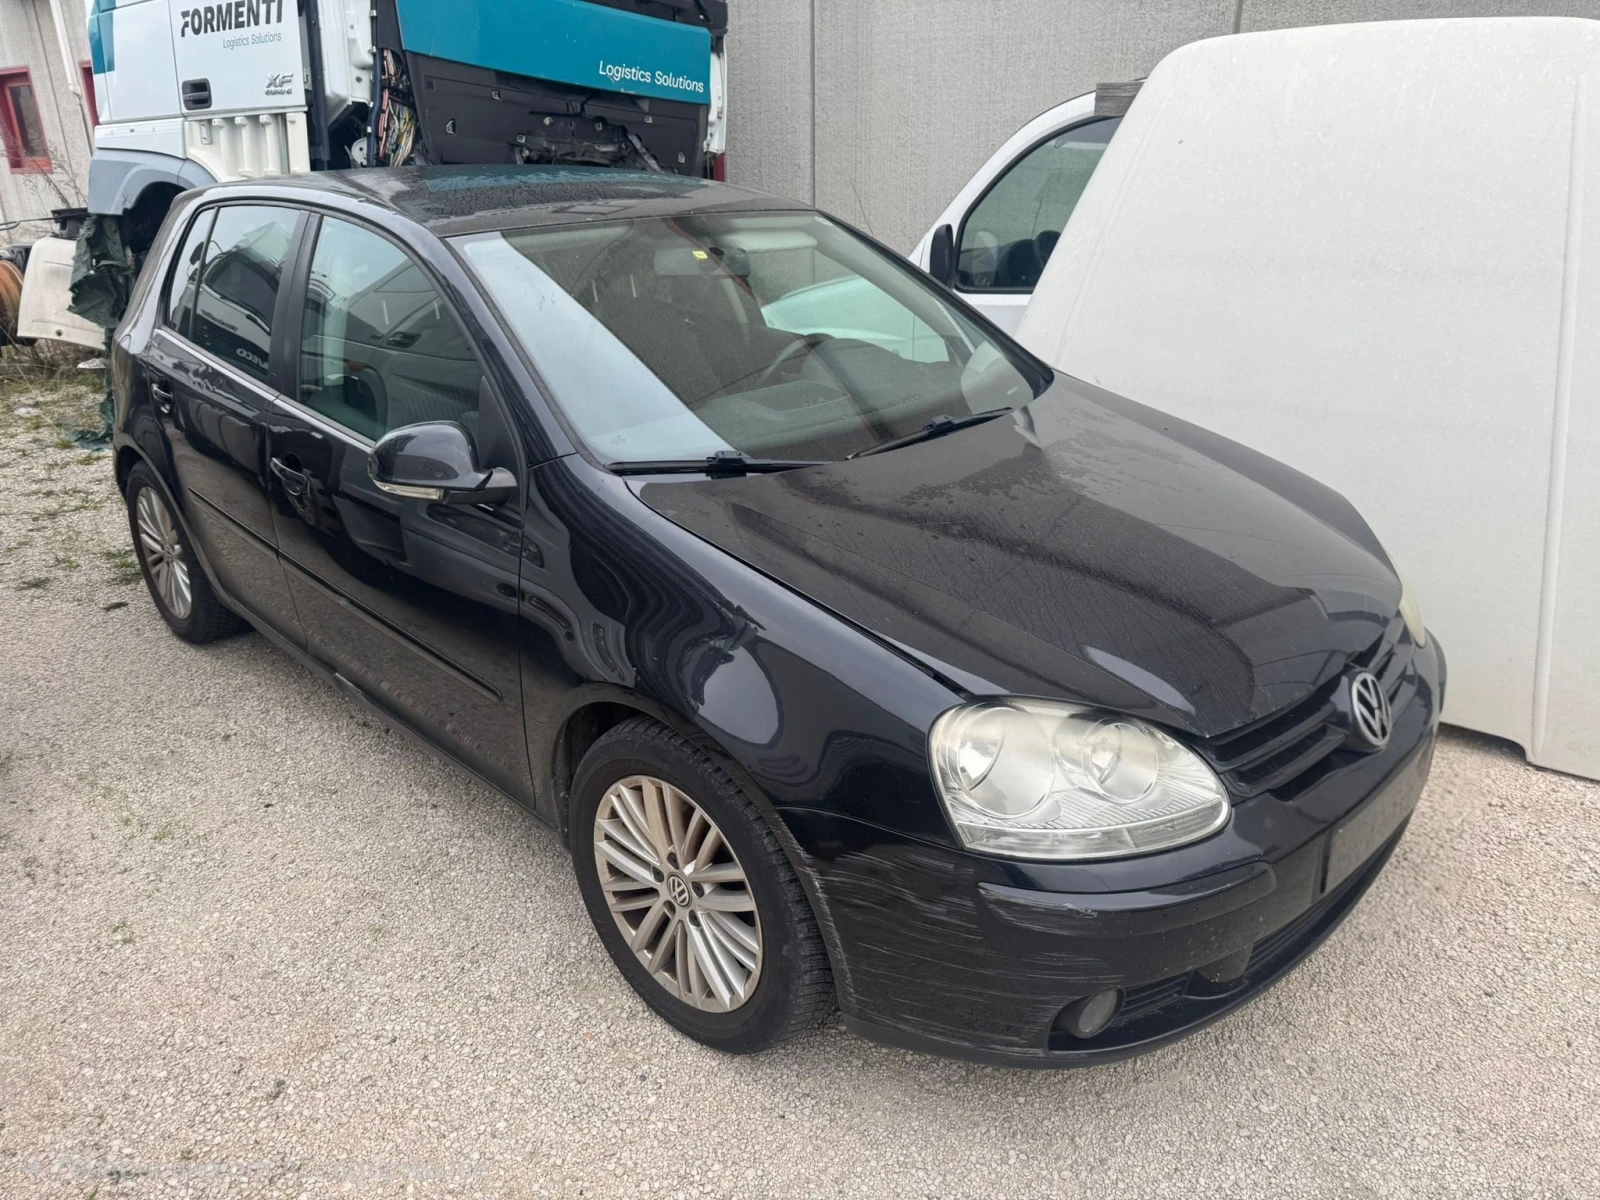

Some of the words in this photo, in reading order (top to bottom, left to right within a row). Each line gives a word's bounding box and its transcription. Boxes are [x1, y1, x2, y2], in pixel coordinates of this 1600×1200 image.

[181, 0, 283, 37] FORMENTI
[222, 35, 249, 50] Logistics
[251, 32, 282, 45] Solutions
[266, 73, 293, 88] XF
[598, 60, 651, 82] Logistics
[654, 70, 704, 93] Solutions
